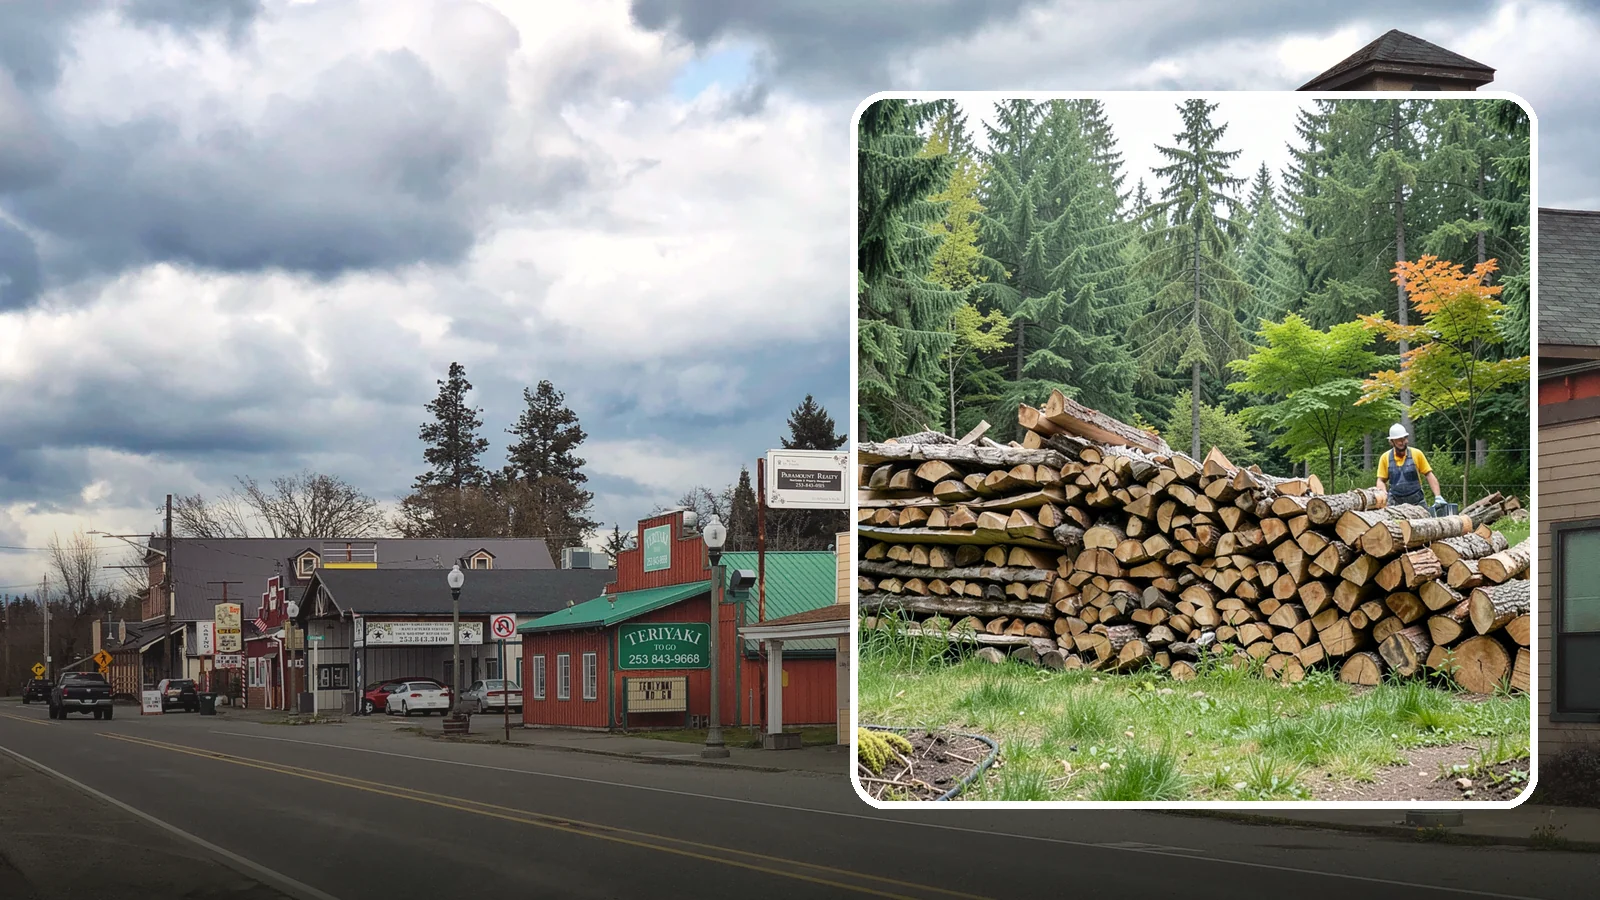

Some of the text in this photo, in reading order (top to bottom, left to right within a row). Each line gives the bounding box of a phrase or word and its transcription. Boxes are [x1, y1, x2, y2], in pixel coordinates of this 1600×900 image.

[624, 627, 703, 646] TERIYAKI
[654, 643, 677, 651] TO GO
[628, 653, 700, 665] 253 843-9668
